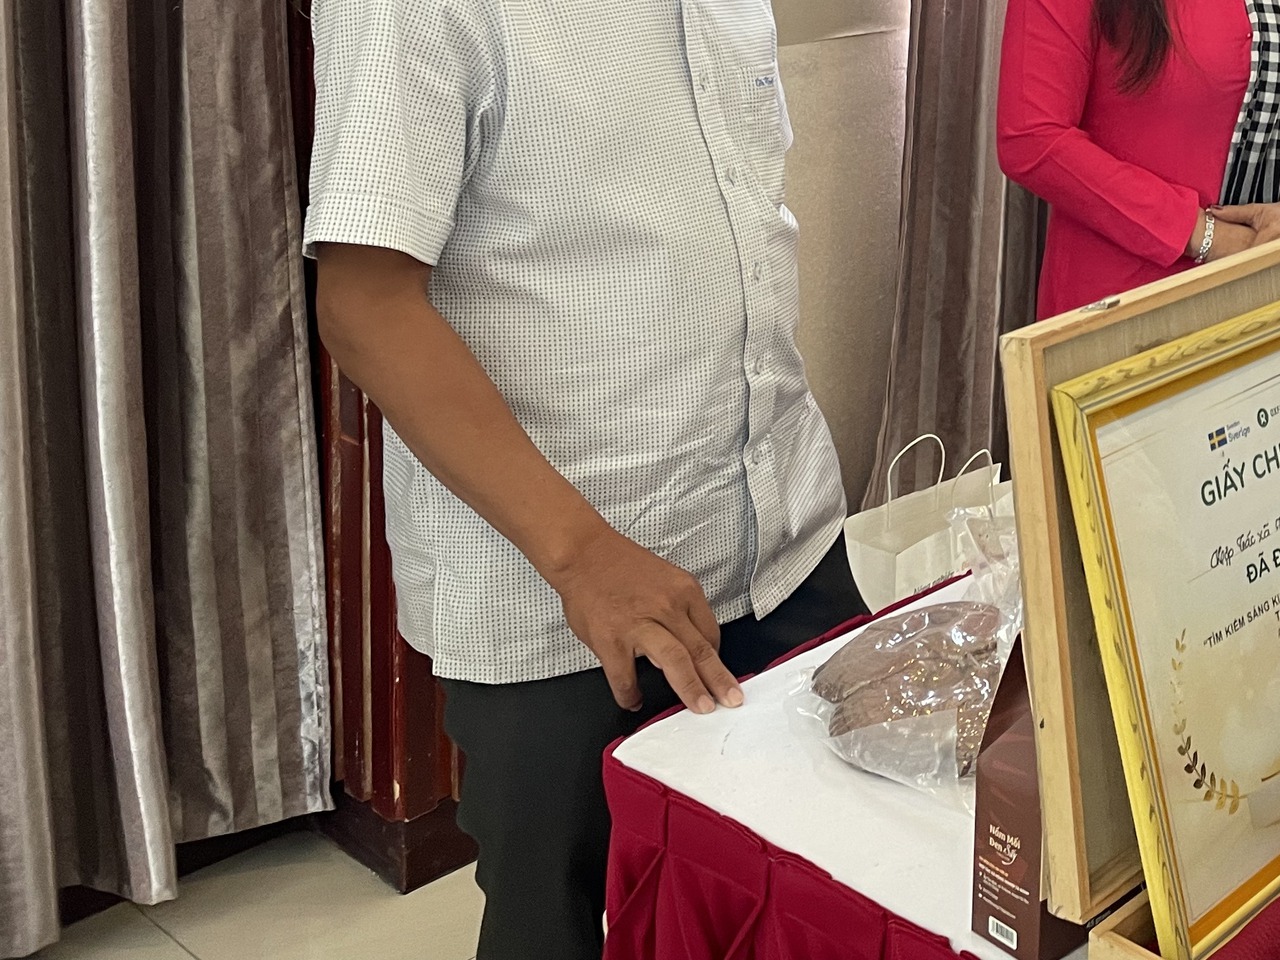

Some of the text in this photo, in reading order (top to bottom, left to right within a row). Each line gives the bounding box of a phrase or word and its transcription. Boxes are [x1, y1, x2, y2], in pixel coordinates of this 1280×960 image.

[1200, 458, 1246, 507] GIẤY
[1246, 552, 1271, 583] ĐÃ
[1246, 600, 1270, 623] SÁNG
